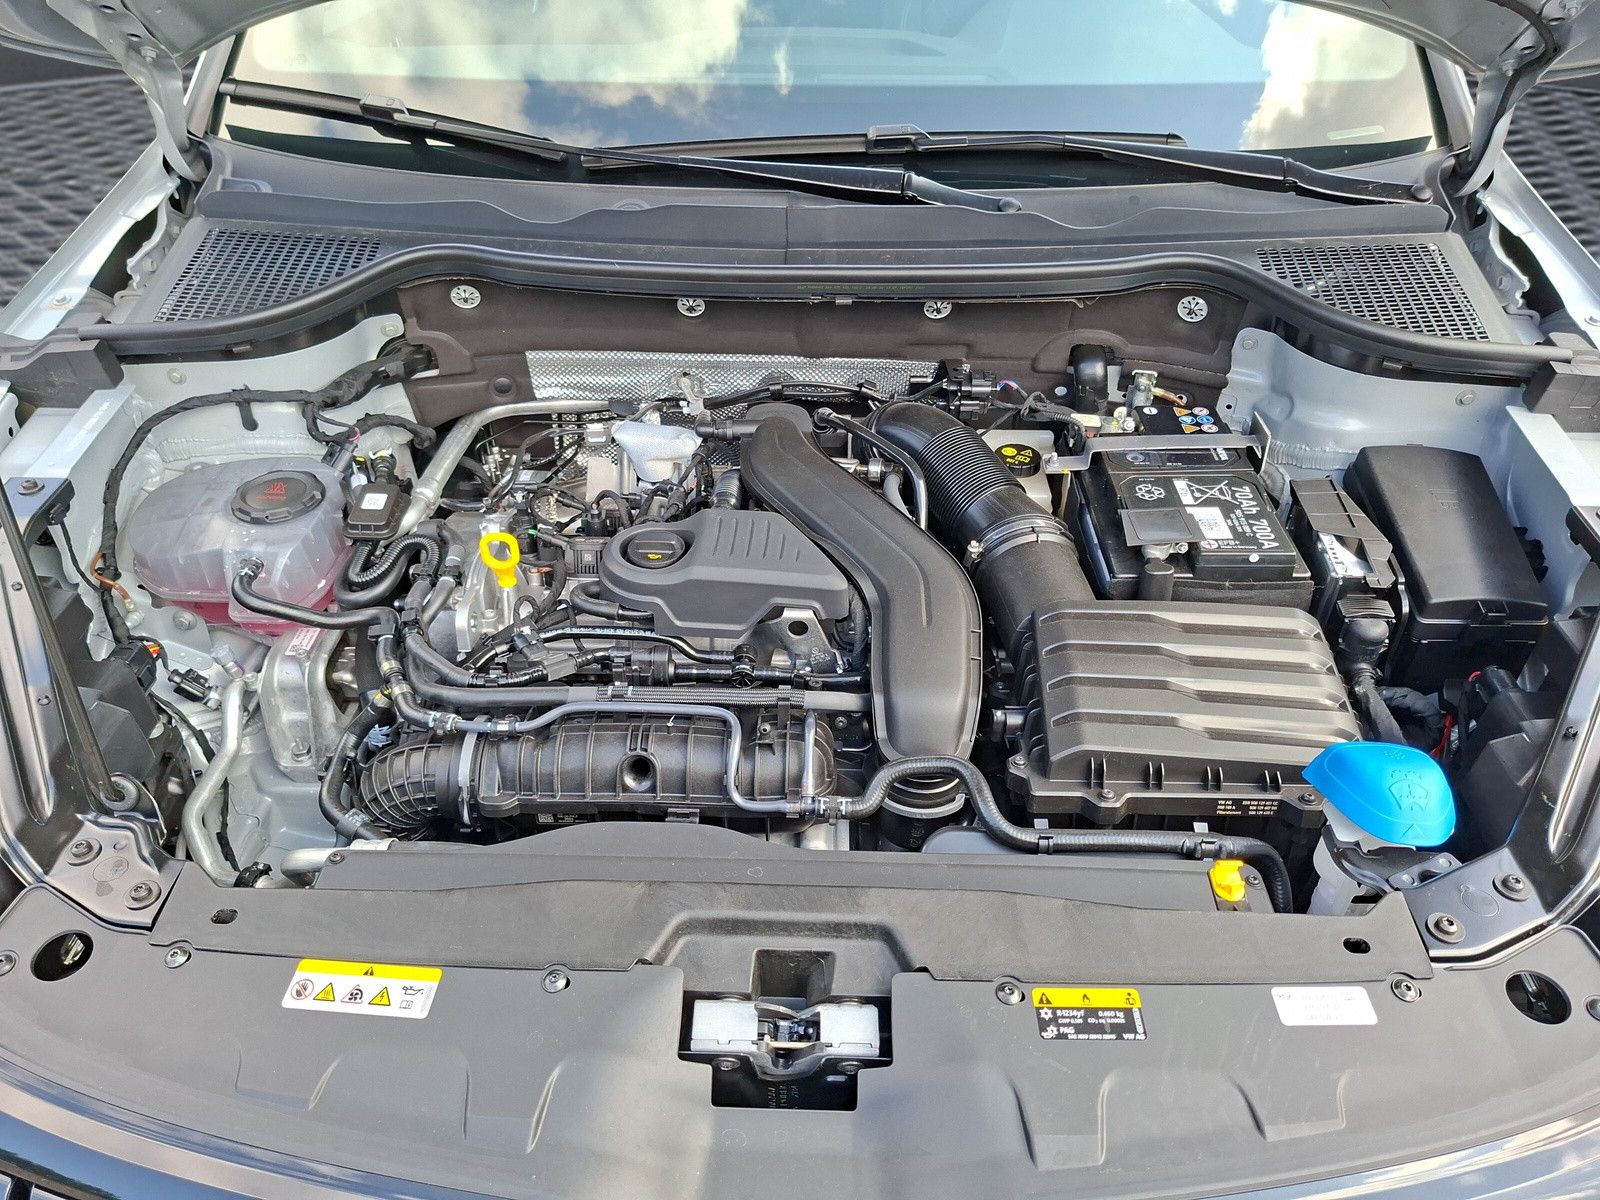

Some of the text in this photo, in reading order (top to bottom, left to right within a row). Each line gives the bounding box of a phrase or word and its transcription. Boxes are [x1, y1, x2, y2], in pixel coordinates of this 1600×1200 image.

[1231, 486, 1260, 514] 70Ah
[1248, 519, 1280, 549] 700A
[1056, 1009, 1085, 1018] R-1234yf
[1116, 1010, 1125, 1019] kg
[1059, 1026, 1076, 1034] PAG
